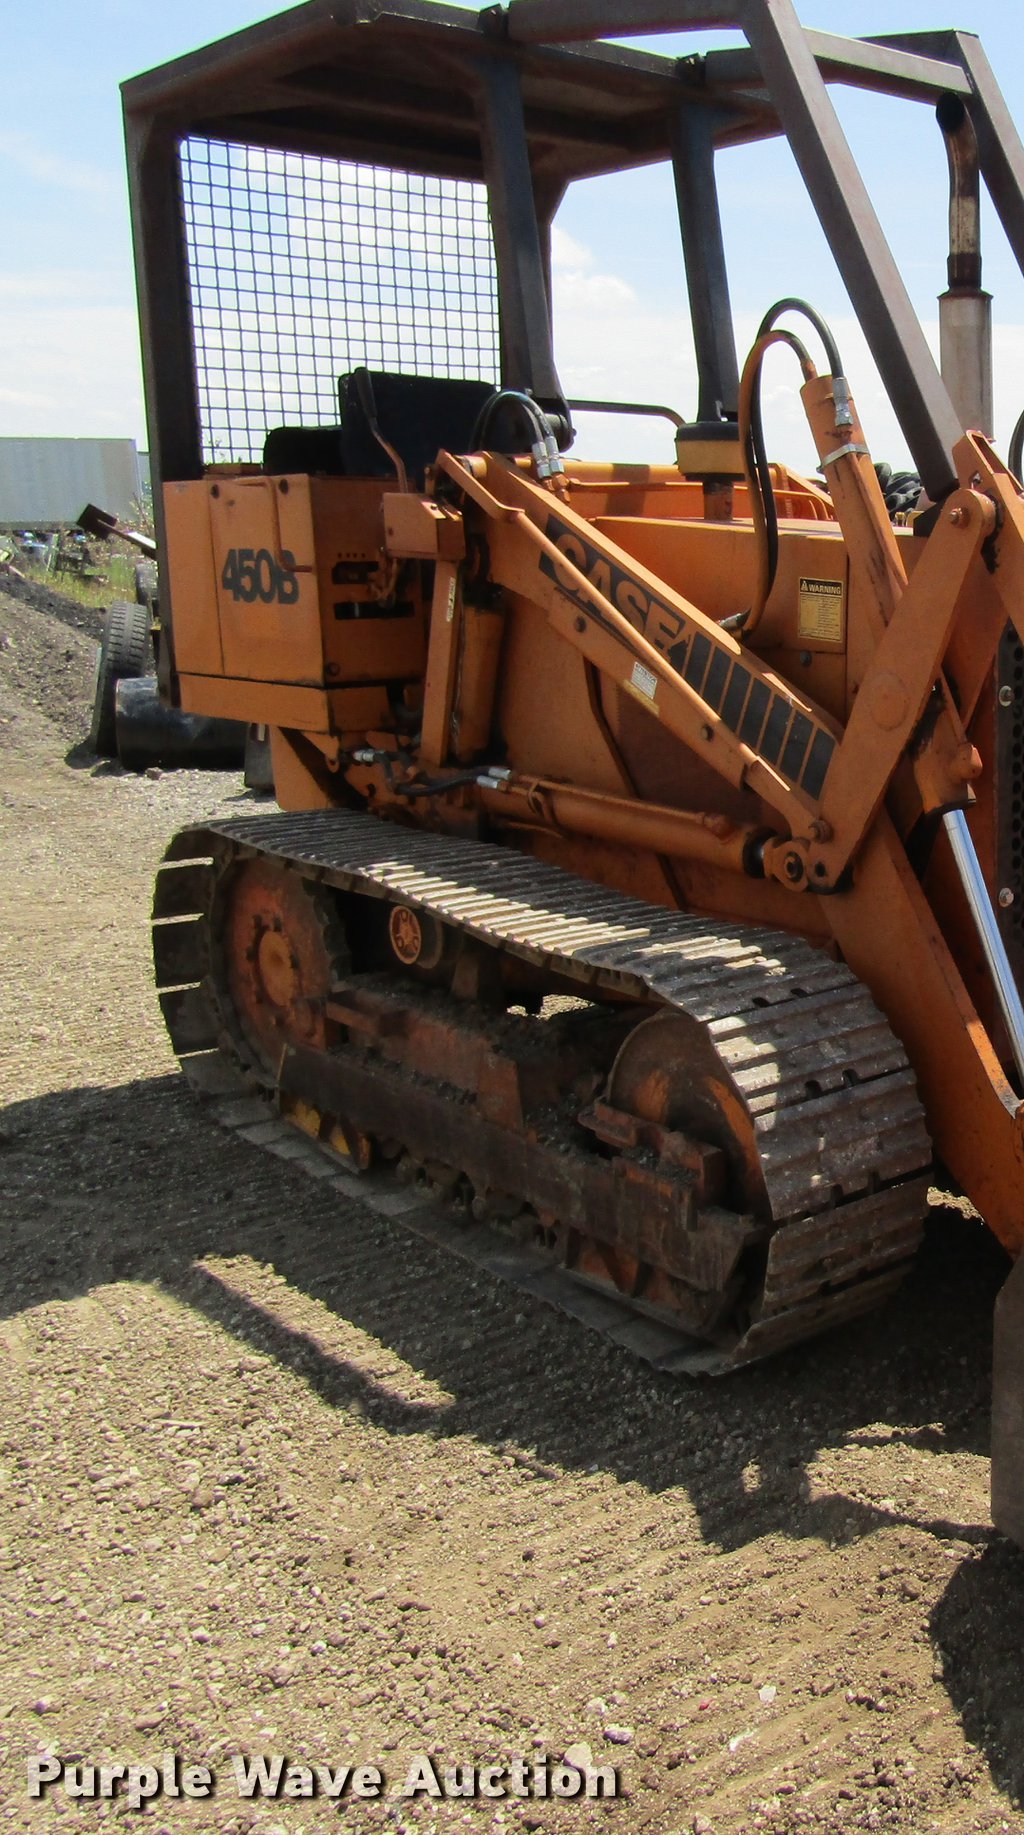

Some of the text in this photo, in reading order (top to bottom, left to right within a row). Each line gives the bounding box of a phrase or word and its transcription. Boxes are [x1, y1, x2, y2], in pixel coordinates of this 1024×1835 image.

[222, 548, 299, 604] 450B
[553, 532, 685, 656] CASE
[808, 583, 841, 595] WARNING
